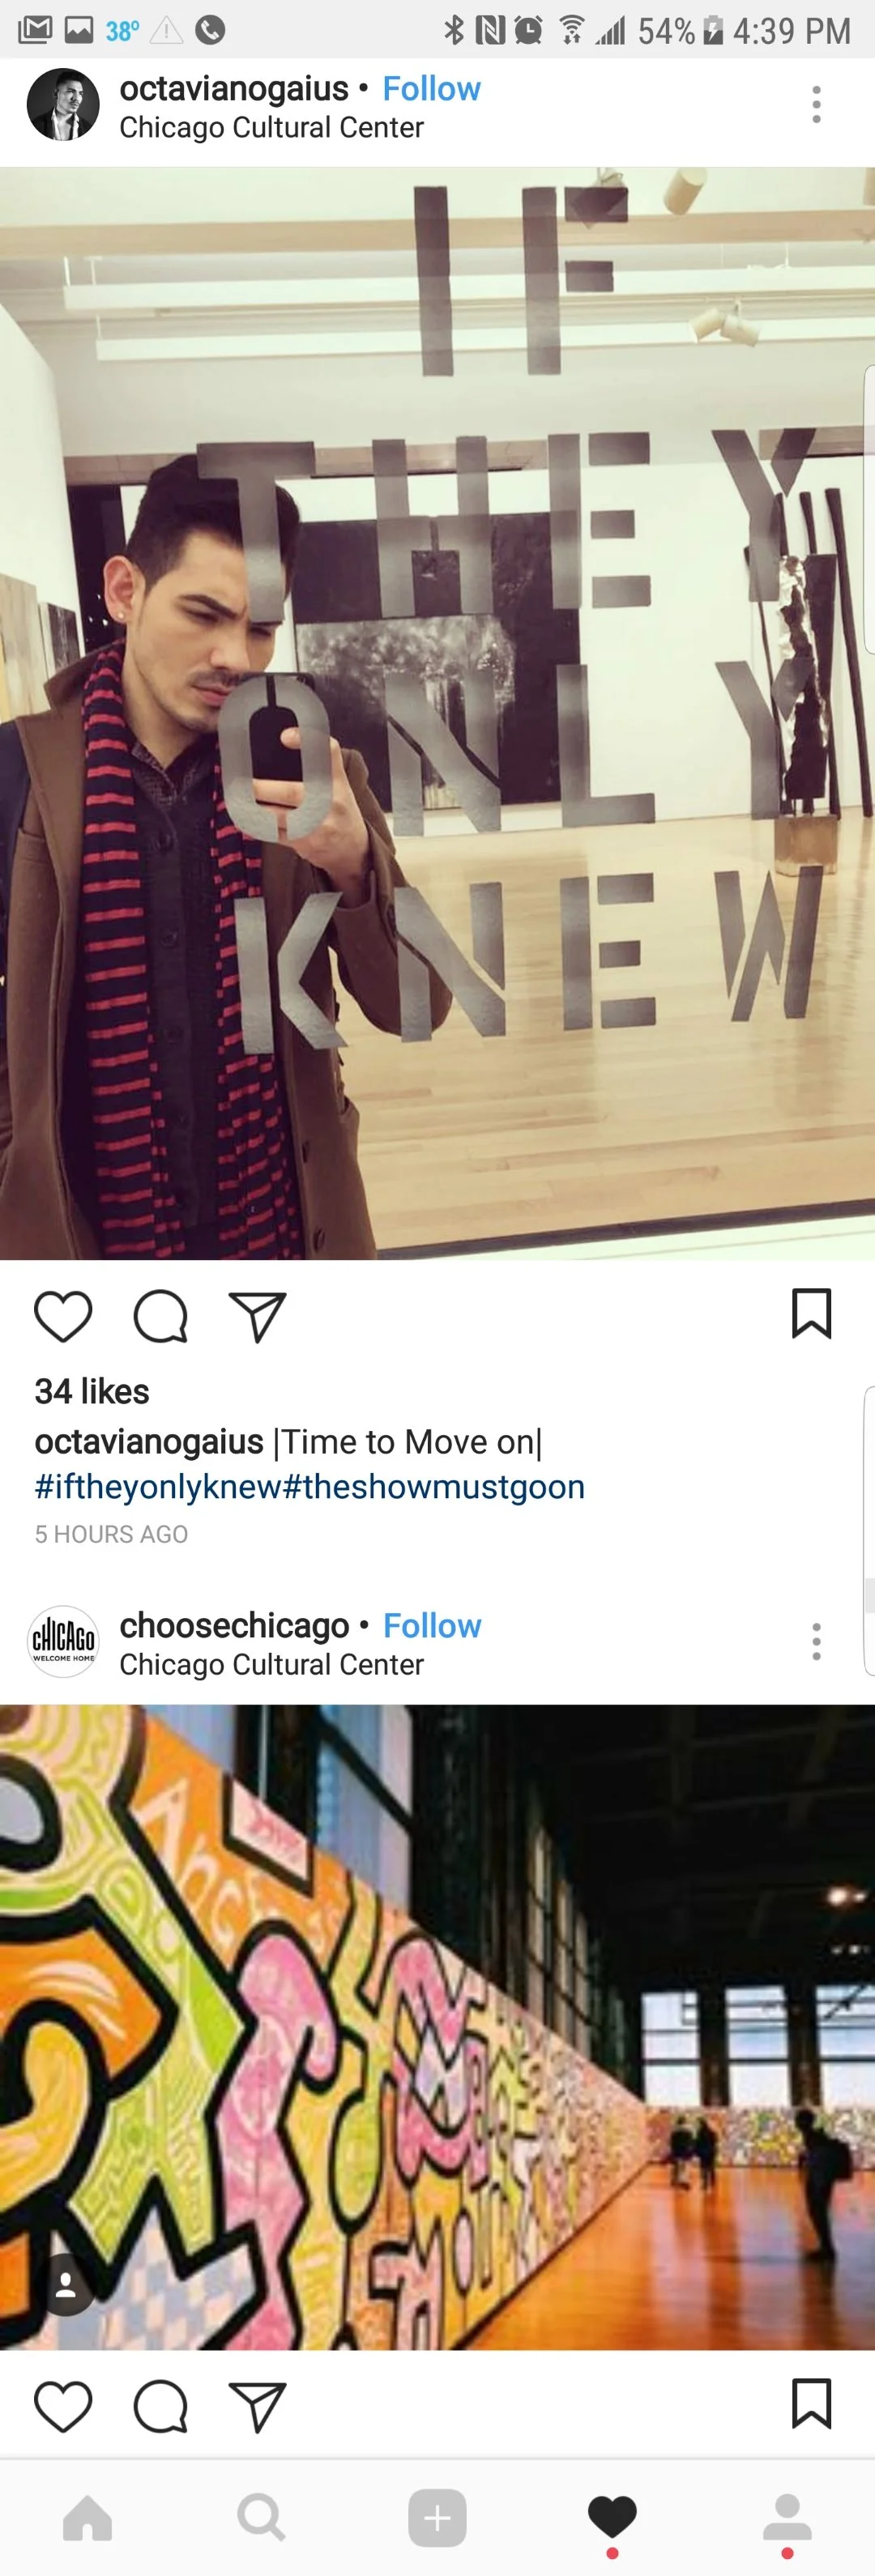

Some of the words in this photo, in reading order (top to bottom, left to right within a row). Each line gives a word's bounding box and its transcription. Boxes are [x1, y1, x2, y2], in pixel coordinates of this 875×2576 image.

[638, 16, 695, 45] 54%
[733, 16, 795, 45] 4:39
[806, 17, 851, 45] PM
[119, 74, 349, 108] octavianogaius
[383, 74, 482, 102] Follow
[120, 114, 225, 144] Chicago
[233, 114, 331, 138] Cultural
[339, 115, 425, 138] Center
[414, 185, 628, 377] IF
[197, 429, 816, 624] THEY
[218, 661, 813, 844] ONLY
[234, 866, 824, 1054] KNEW
[35, 1377, 73, 1405] 34
[82, 1376, 150, 1405] likes
[34, 1427, 264, 1462] octavianogaius
[365, 1430, 395, 1455] to
[406, 1429, 488, 1455] Move
[35, 1525, 48, 1543] 5
[54, 1524, 134, 1543] HOURS
[139, 1524, 188, 1543] AGO
[119, 1610, 350, 1646] choosechicago
[384, 1611, 483, 1639] Follow
[120, 1652, 225, 1681] Chicago
[233, 1652, 331, 1676] Cultural
[339, 1652, 425, 1676] Center
